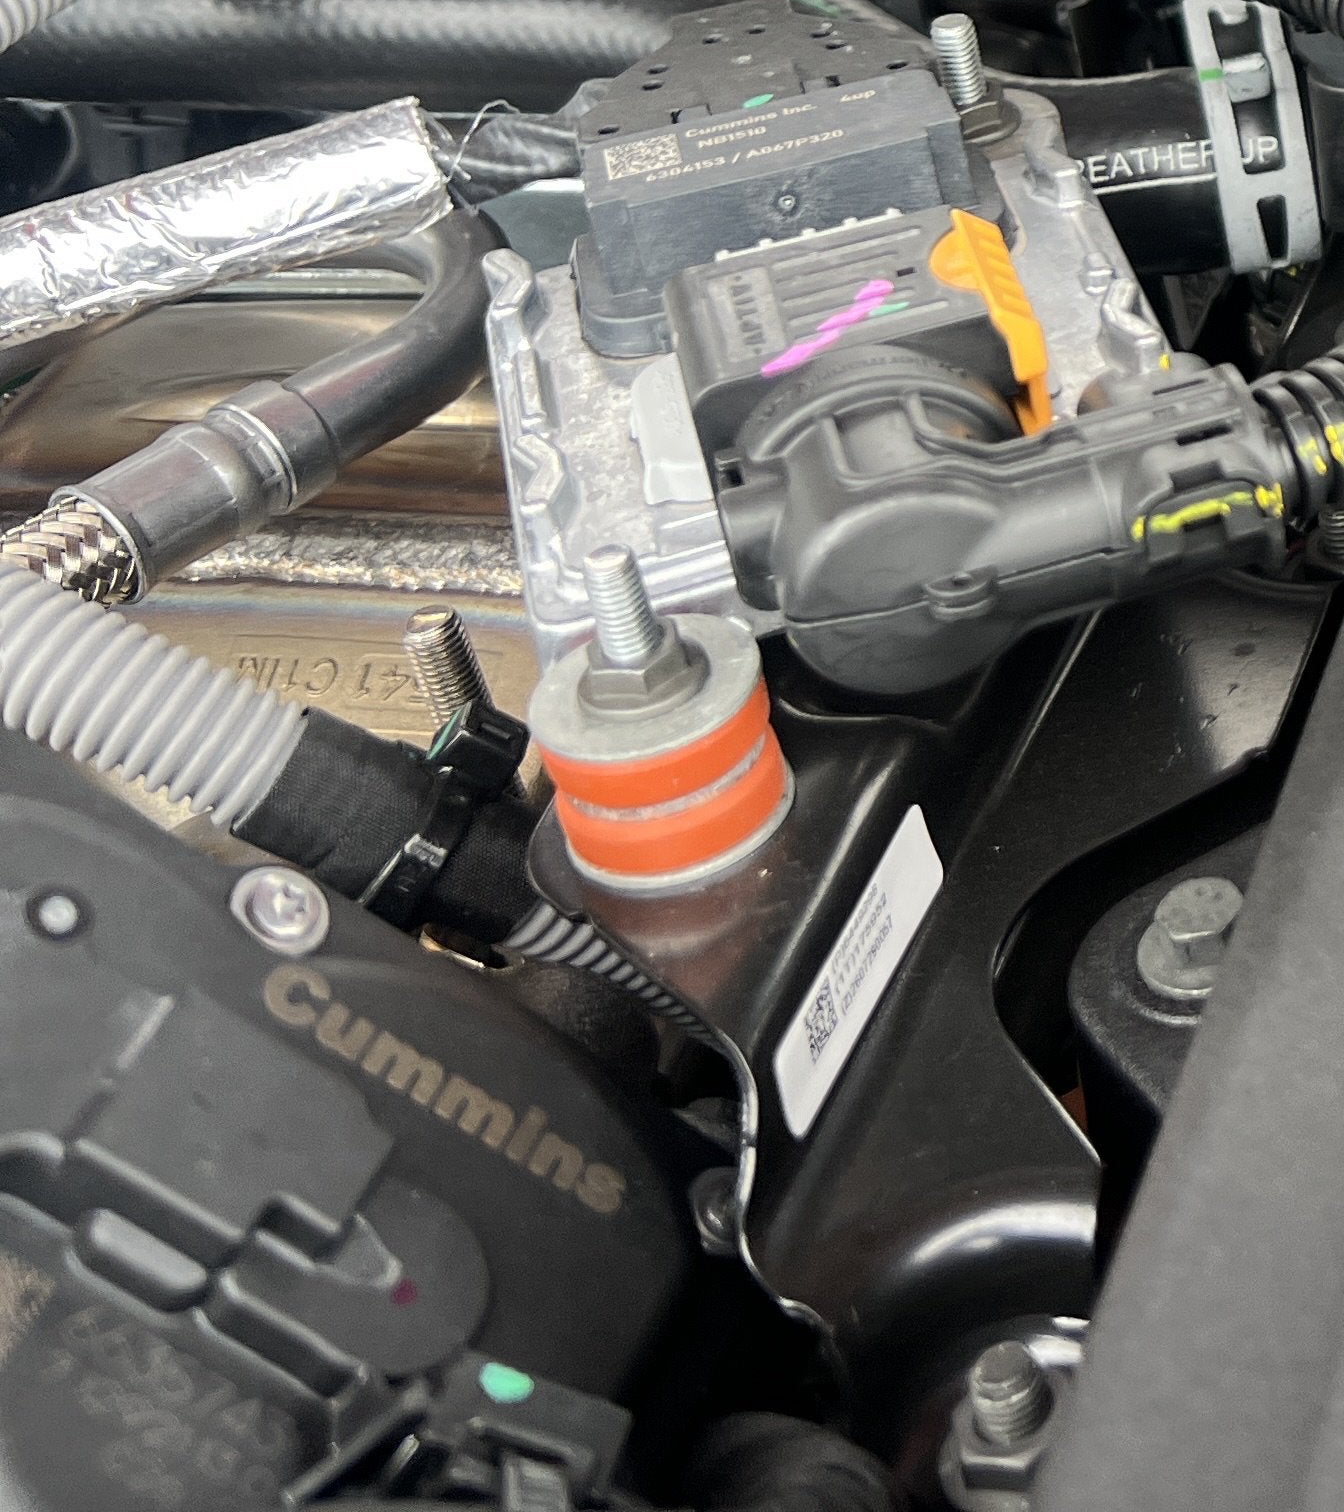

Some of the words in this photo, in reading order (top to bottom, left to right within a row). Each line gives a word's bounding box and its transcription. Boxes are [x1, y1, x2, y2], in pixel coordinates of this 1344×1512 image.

[685, 112, 778, 138] Cummins
[783, 102, 818, 117] Inc.
[264, 962, 627, 1215] Cummins
